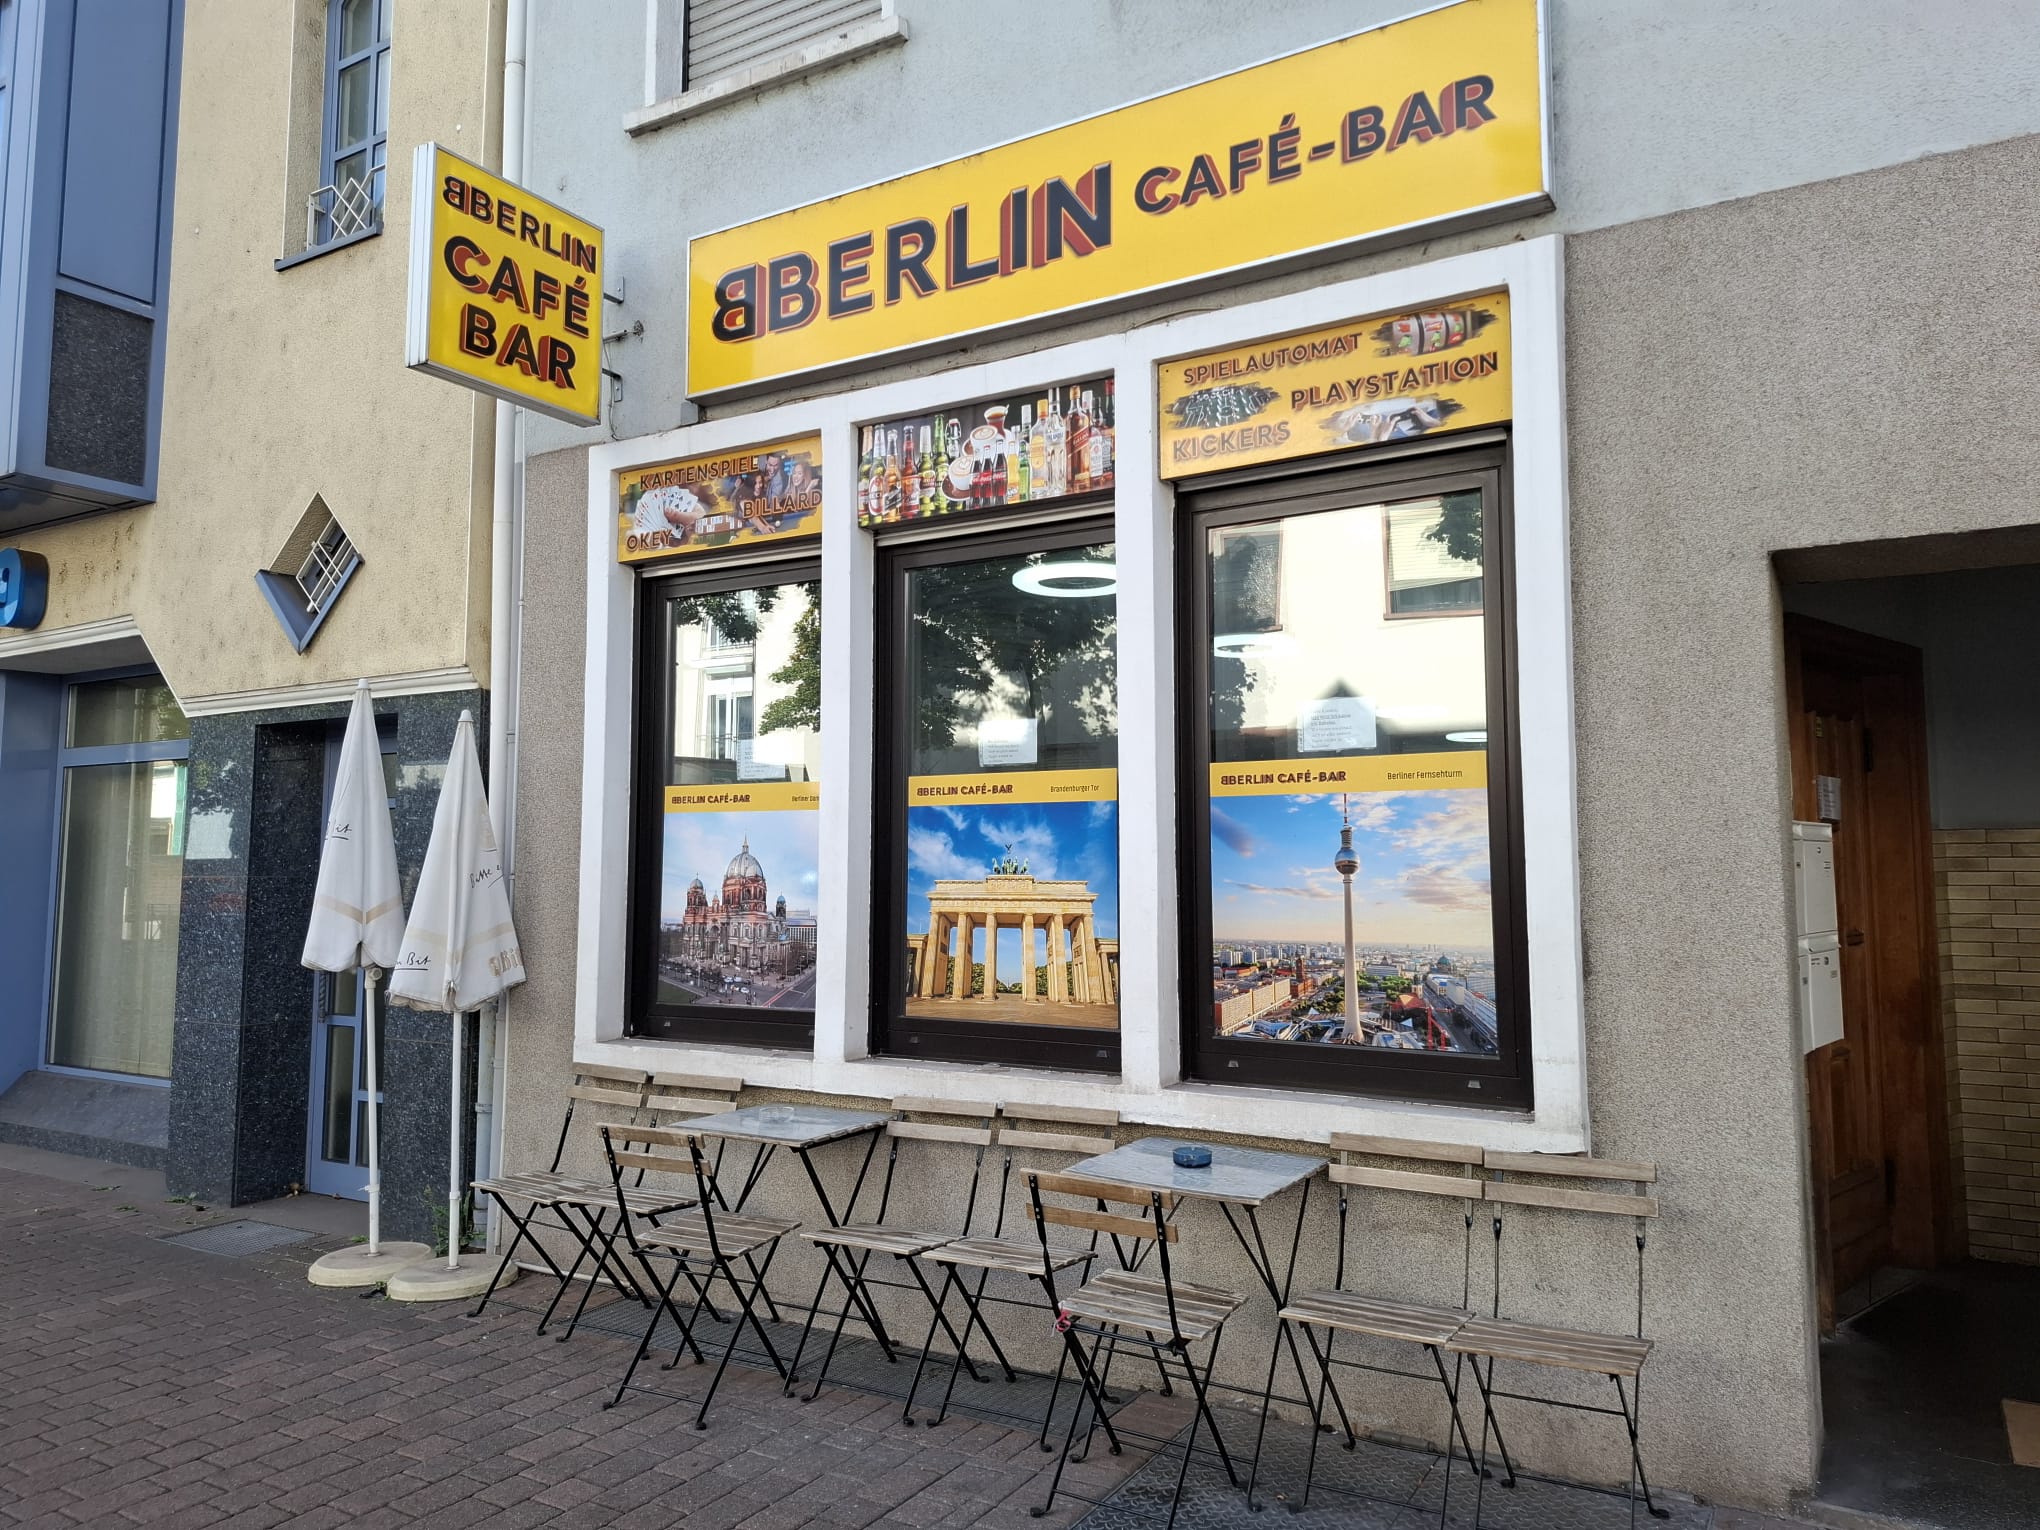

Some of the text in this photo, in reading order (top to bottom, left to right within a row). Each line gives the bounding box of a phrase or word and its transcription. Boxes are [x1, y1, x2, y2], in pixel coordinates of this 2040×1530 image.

[1134, 74, 1497, 215] CAFÉ-BAR
[444, 235, 591, 338] CAFÉ
[460, 302, 576, 390] BAR
[1183, 333, 1363, 386] SPIELAUTOMAT
[1291, 351, 1499, 411] PLAYSTATION
[1172, 421, 1292, 462] KICKERS
[640, 455, 759, 491] KARTENSPIEL
[743, 490, 822, 518] BILLARD
[627, 530, 673, 551] OKEY
[960, 782, 1014, 795] CAFÉ-BAR
[1050, 784, 1100, 794] Brandenburger Tor
[1277, 769, 1347, 784] CAFÉ-BAR
[1387, 769, 1463, 780] Berliner Fernsehturm
[707, 792, 751, 804] CAFÉ-BAR
